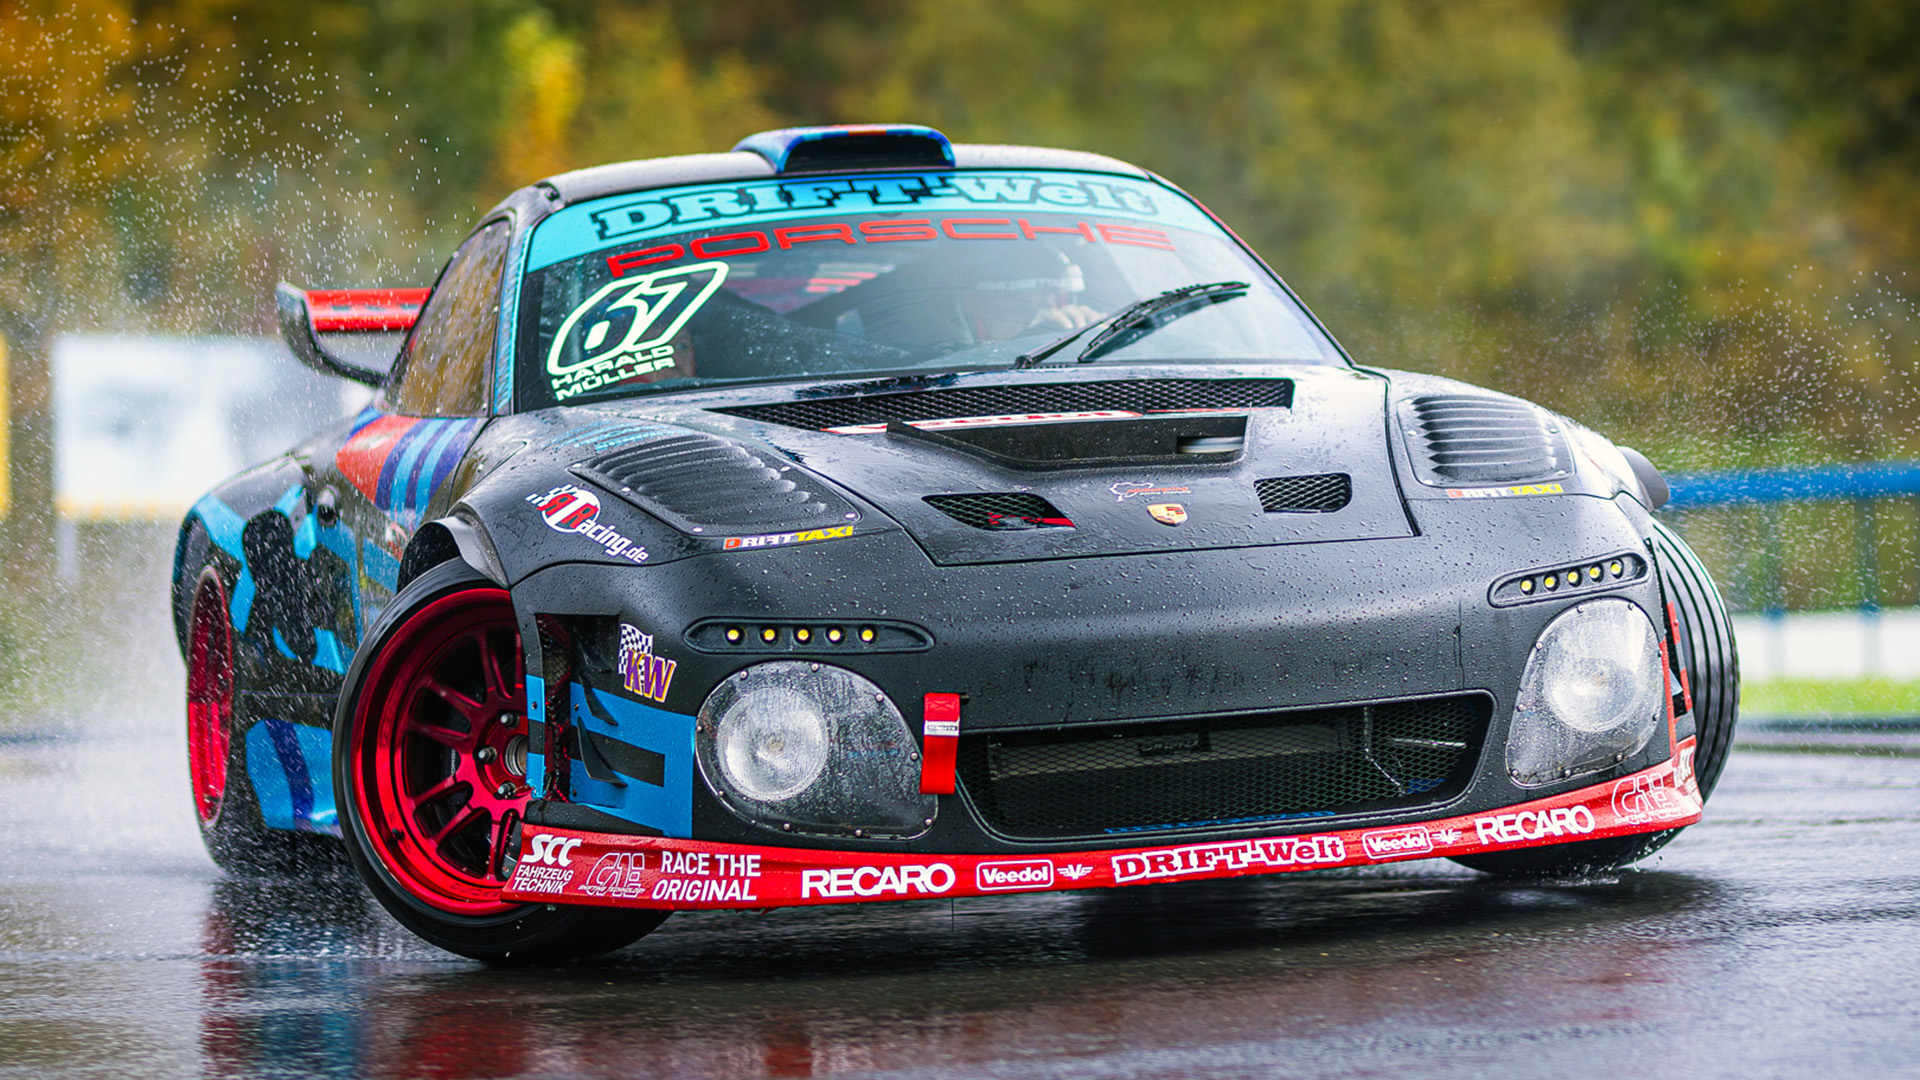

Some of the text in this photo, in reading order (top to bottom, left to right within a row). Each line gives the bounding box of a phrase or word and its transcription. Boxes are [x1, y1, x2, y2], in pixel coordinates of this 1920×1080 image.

[589, 176, 1158, 240] DRIFT-Welt
[606, 218, 1176, 277] PORSCHE
[547, 261, 730, 376] 67
[551, 345, 675, 389] HARALD
[555, 357, 676, 401] MÜLLER
[624, 649, 677, 703] KW
[1367, 833, 1429, 852] Veedol
[1475, 804, 1596, 845] RECARO
[521, 833, 583, 868] SCC
[660, 850, 762, 877] RACE THE
[1112, 836, 1345, 883] DRIFT-Welt
[512, 877, 570, 895] TECHNIK
[516, 865, 574, 882] FAHRZEUG
[651, 879, 758, 902] ORIGINAL
[801, 863, 956, 899] RECARO
[982, 866, 1048, 884] Veedol
